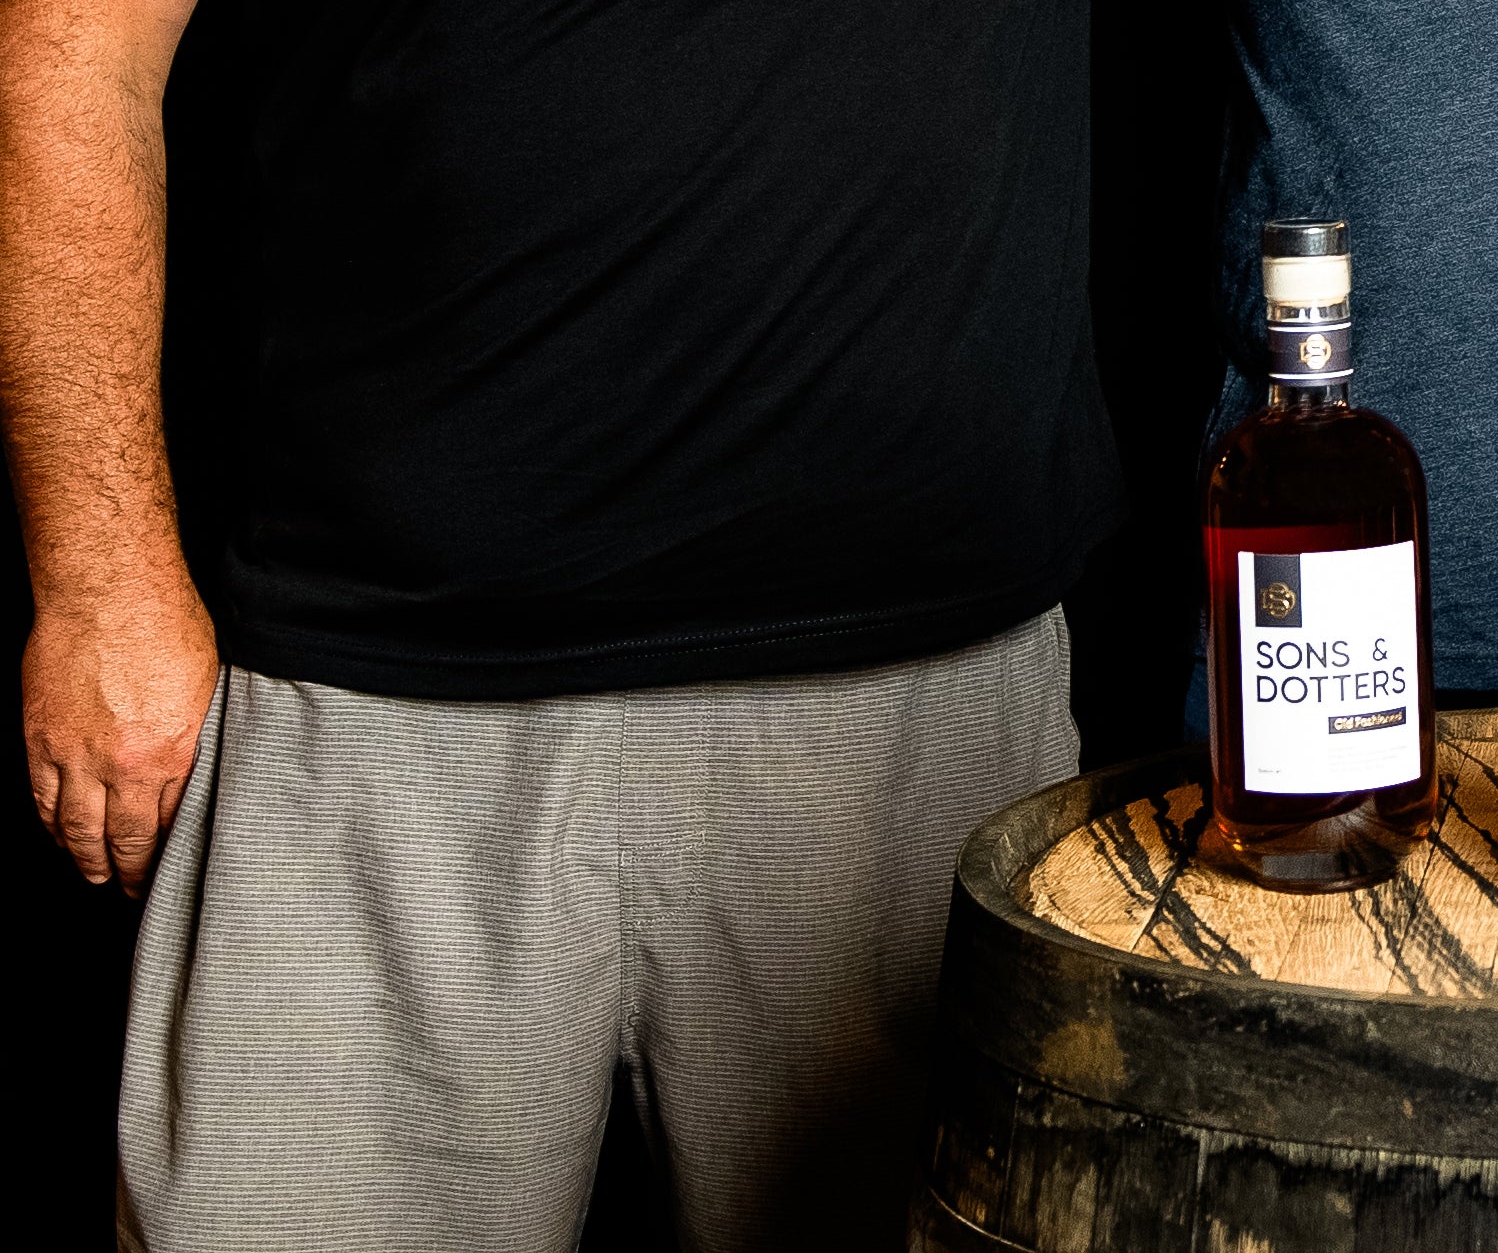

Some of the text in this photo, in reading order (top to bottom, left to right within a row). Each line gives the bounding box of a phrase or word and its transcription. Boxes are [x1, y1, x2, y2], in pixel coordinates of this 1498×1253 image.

[1256, 637, 1388, 669] SONS &
[1256, 666, 1406, 703] DOTTERS
